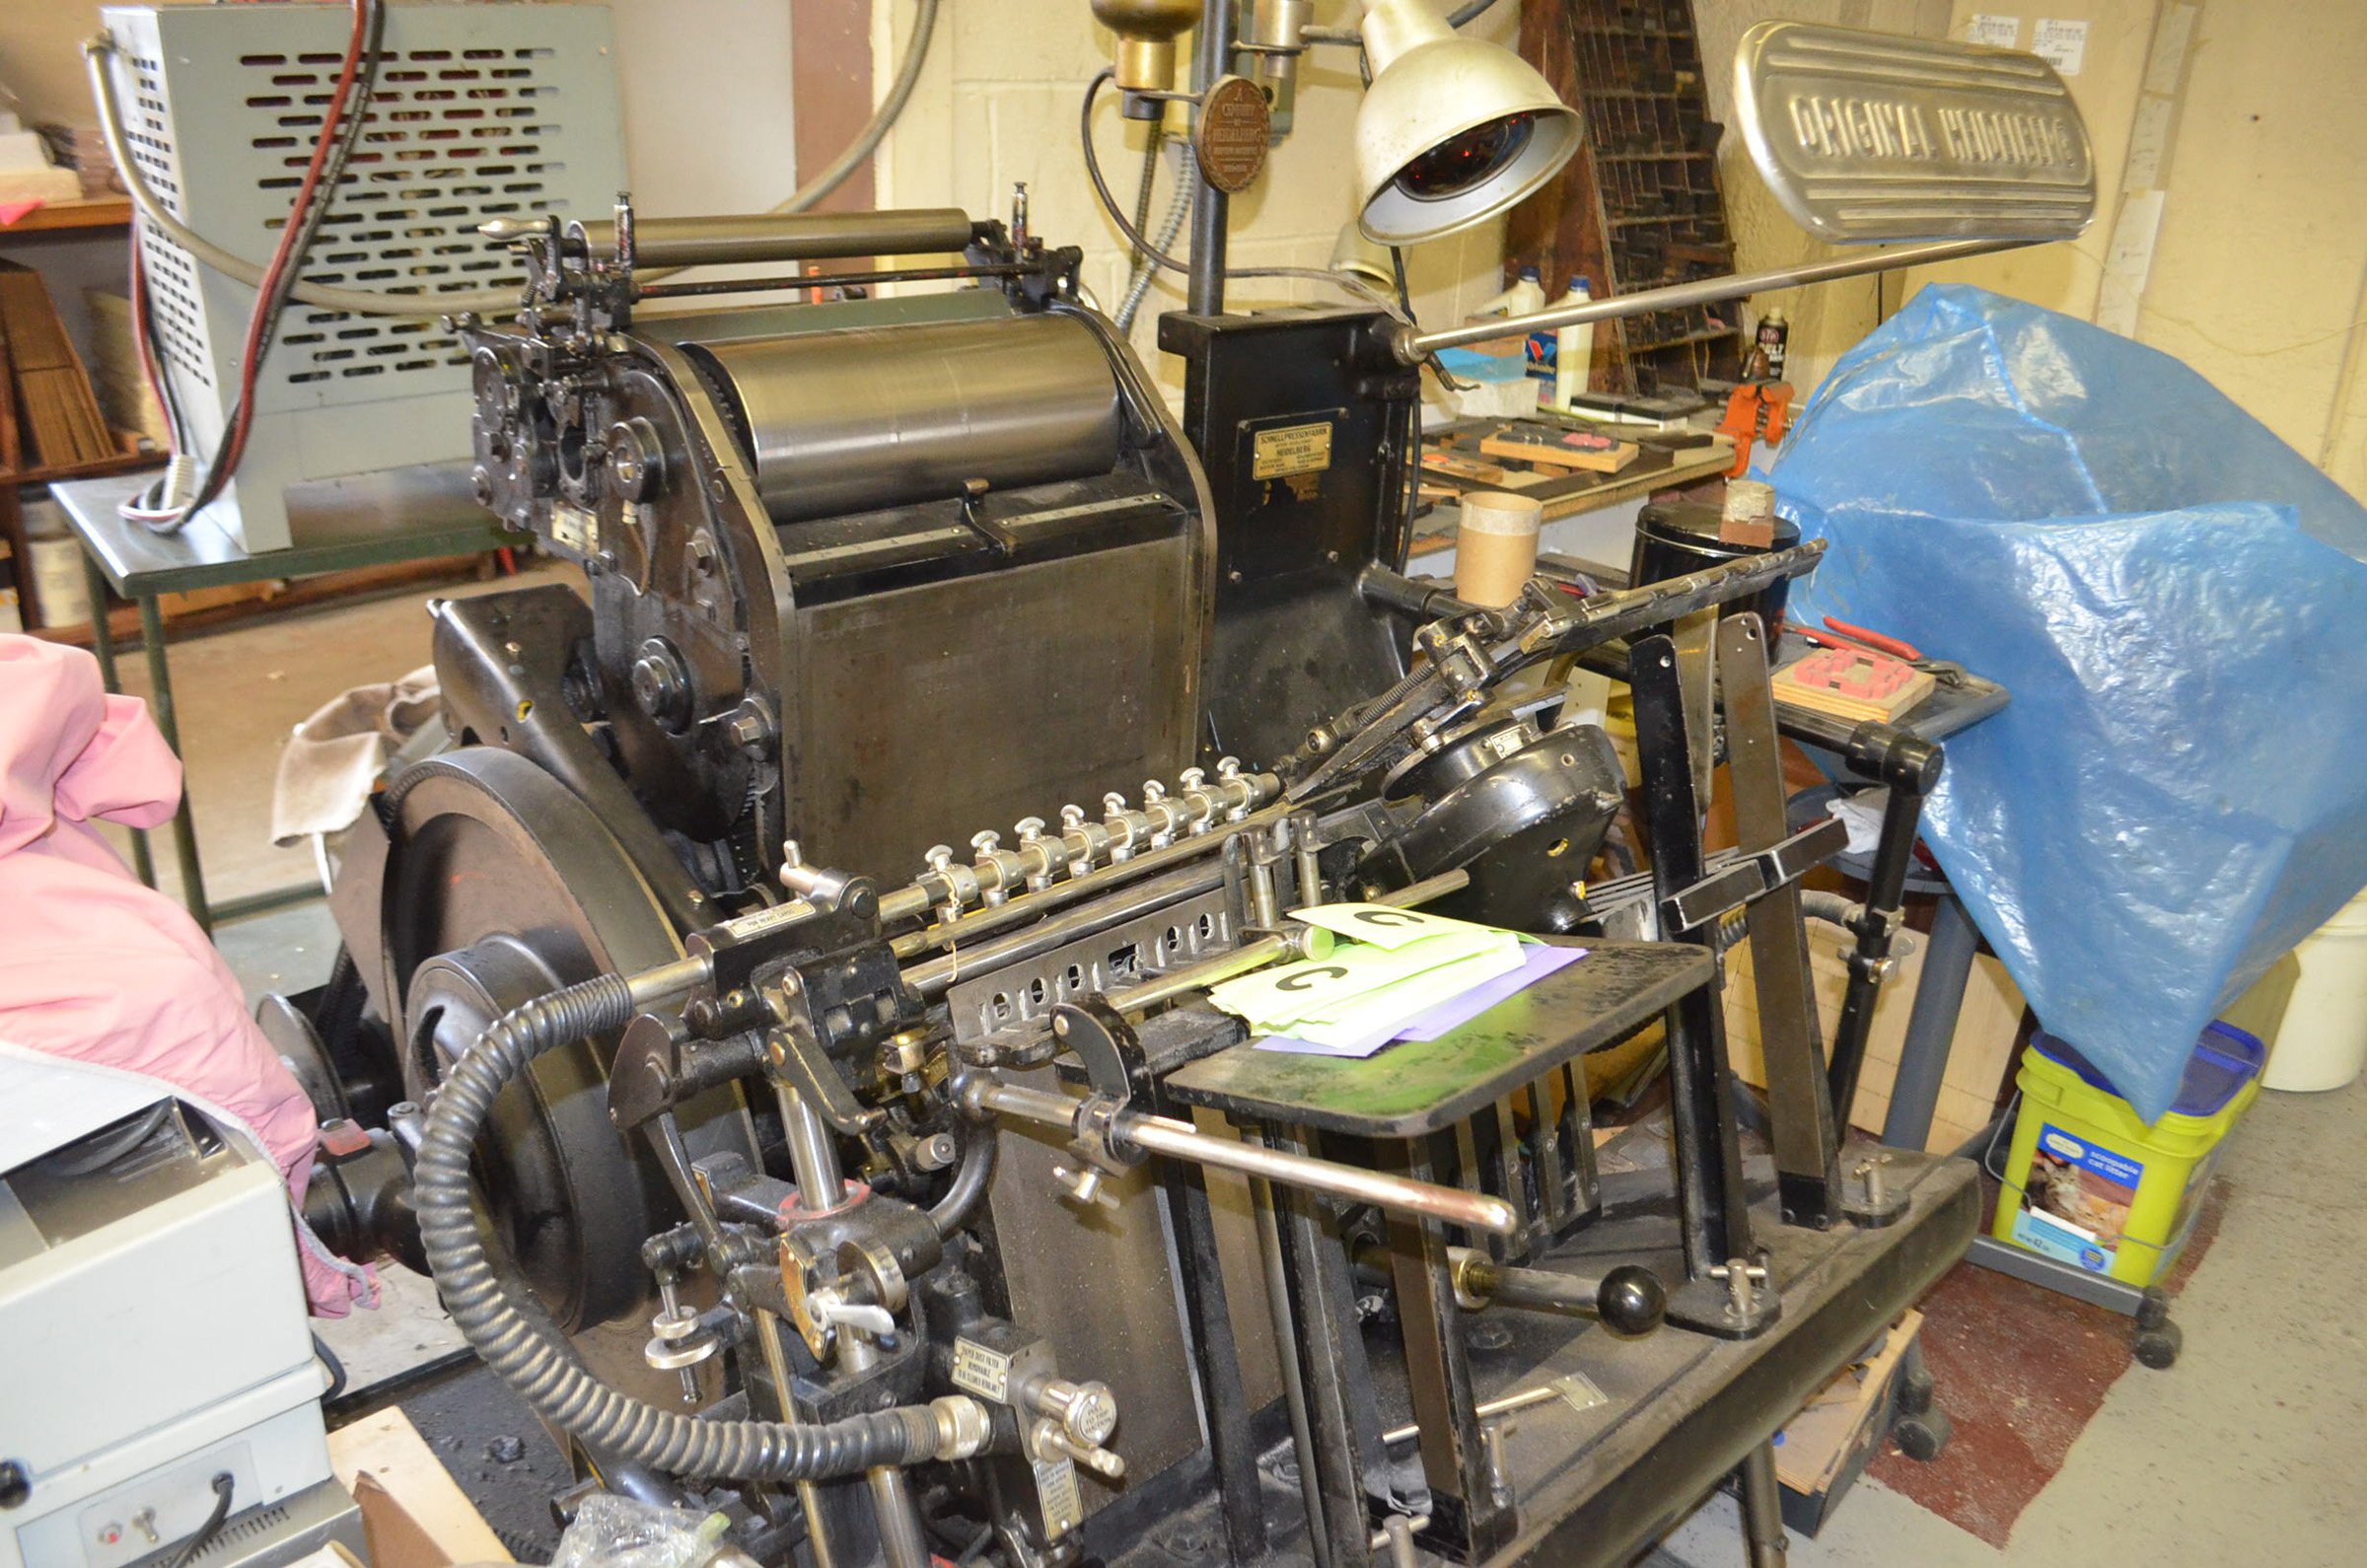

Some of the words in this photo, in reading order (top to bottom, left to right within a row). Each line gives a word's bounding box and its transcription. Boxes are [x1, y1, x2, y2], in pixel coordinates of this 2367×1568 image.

[1788, 96, 1936, 159] ORIGINAL
[1937, 107, 2075, 167] HEIDELBERG
[1275, 966, 1348, 991] C
[2090, 1151, 2140, 1176] scoopable
[2105, 1163, 2130, 1179] litter
[985, 1356, 999, 1369] FILTER
